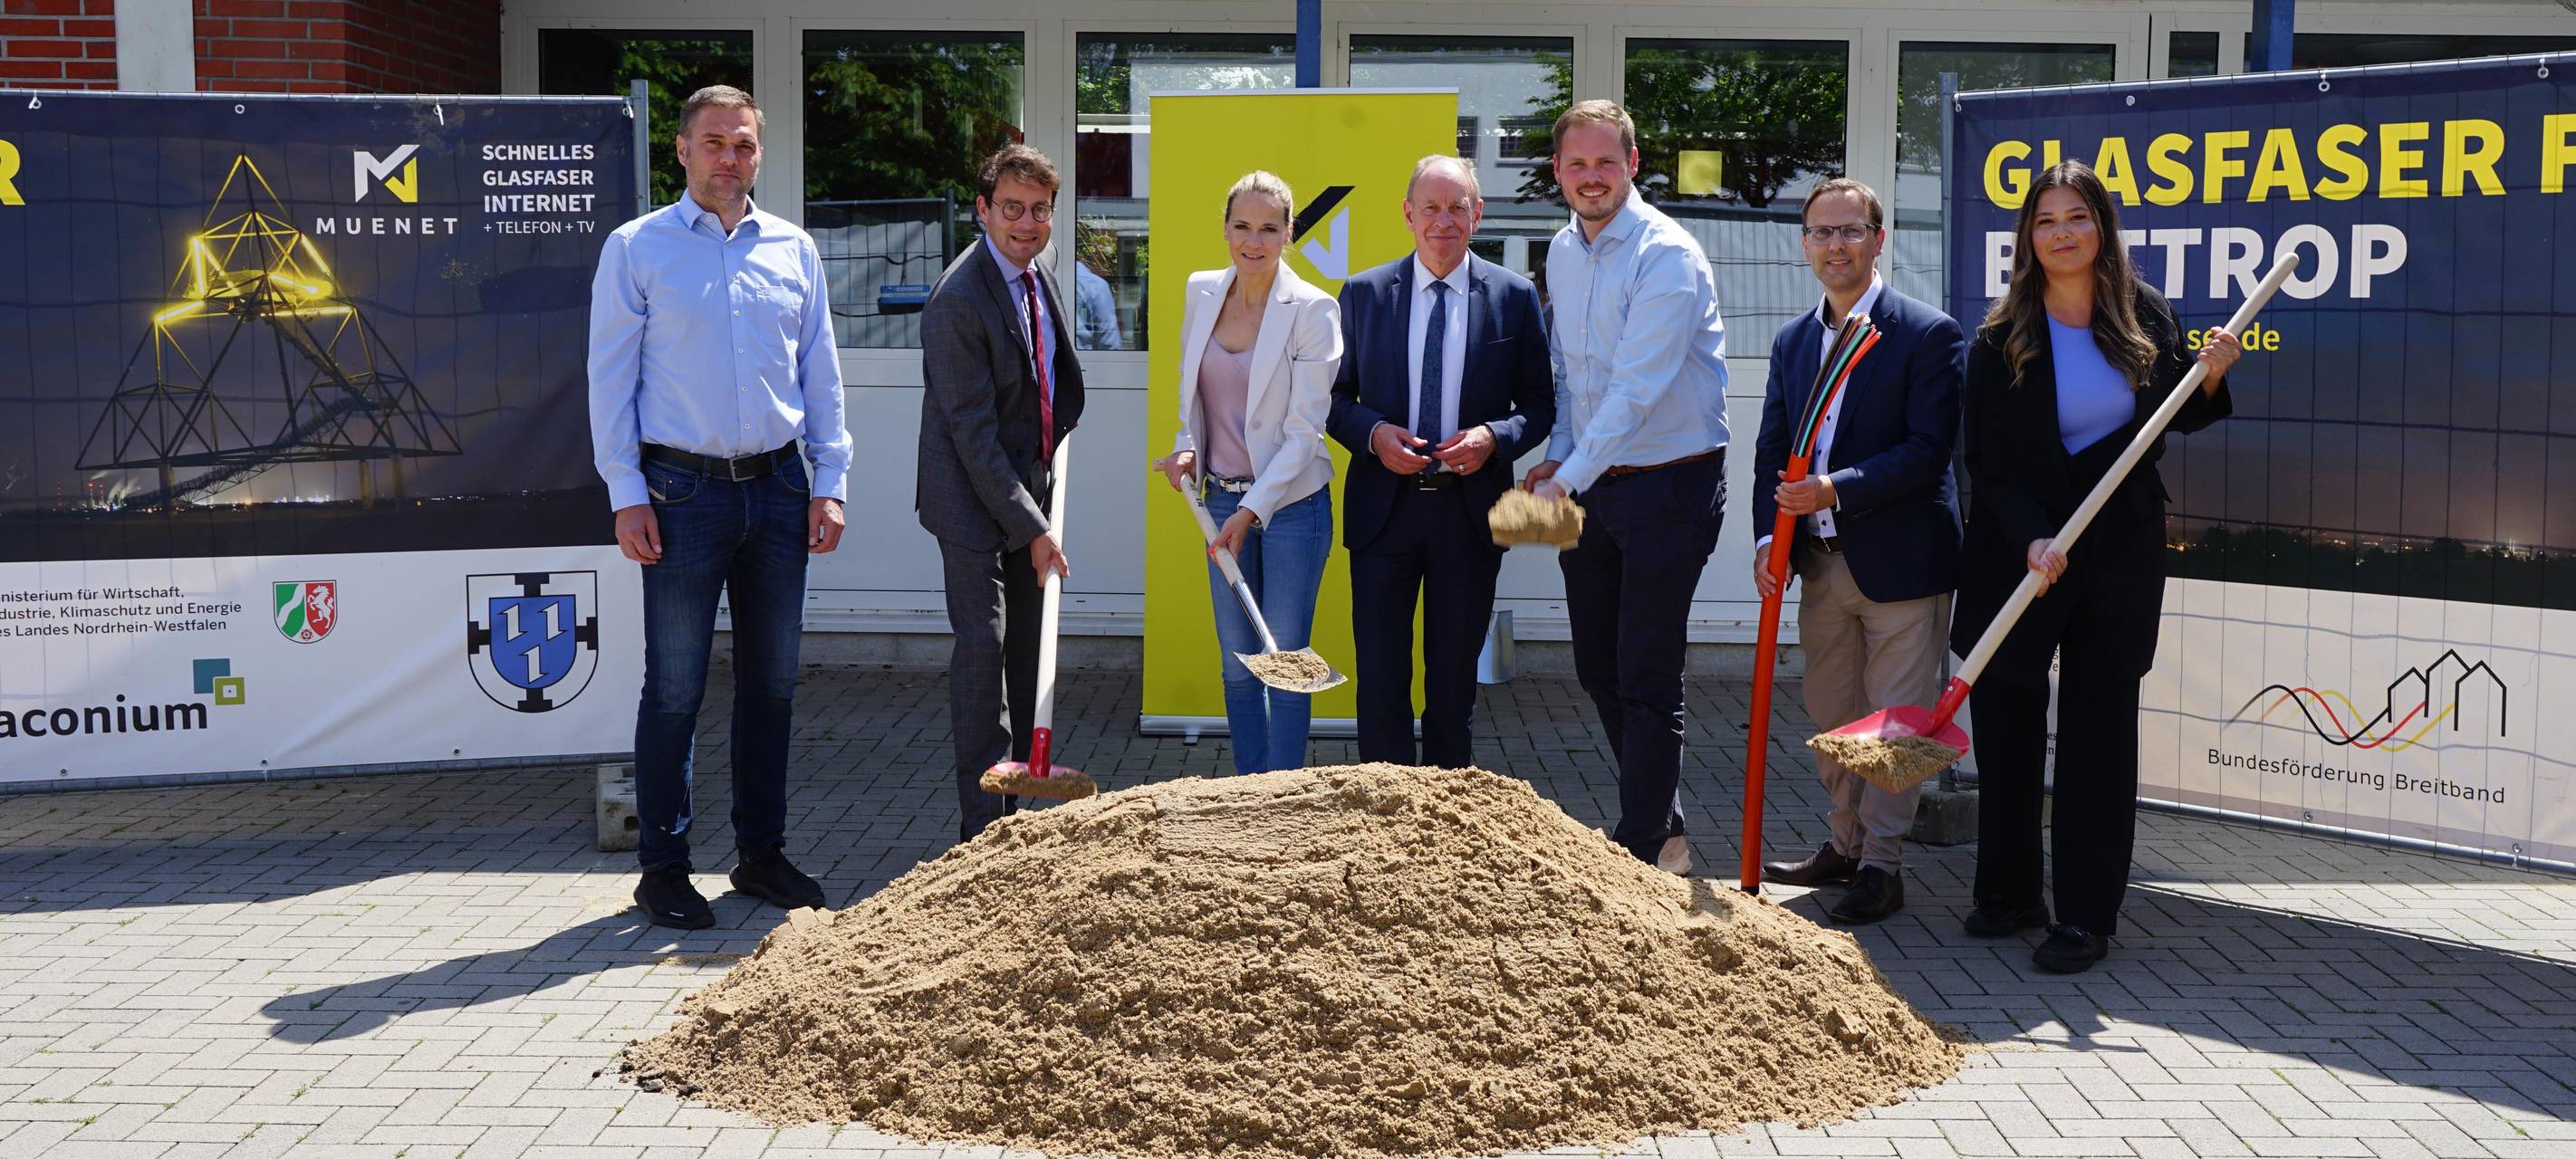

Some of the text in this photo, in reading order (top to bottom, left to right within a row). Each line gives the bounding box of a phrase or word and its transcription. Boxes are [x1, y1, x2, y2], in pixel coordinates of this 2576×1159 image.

[482, 144, 594, 160] SCHNELLES
[483, 169, 594, 186] GLASFASER
[484, 194, 595, 213] INTERNET
[315, 217, 458, 235] MUENET
[496, 221, 562, 234] TELEFON
[576, 221, 594, 233] TV
[1985, 224, 2408, 300] BTROP
[1, 587, 185, 602] nisterium für Wirtschaft,
[0, 601, 242, 619] dustrie, Klimaschutz und Energie
[15, 624, 69, 637] Landes
[73, 619, 227, 635] Nordrhein-Westfalen
[0, 694, 207, 738] aconium
[2208, 749, 2505, 803] Bundesförderung Breitband
